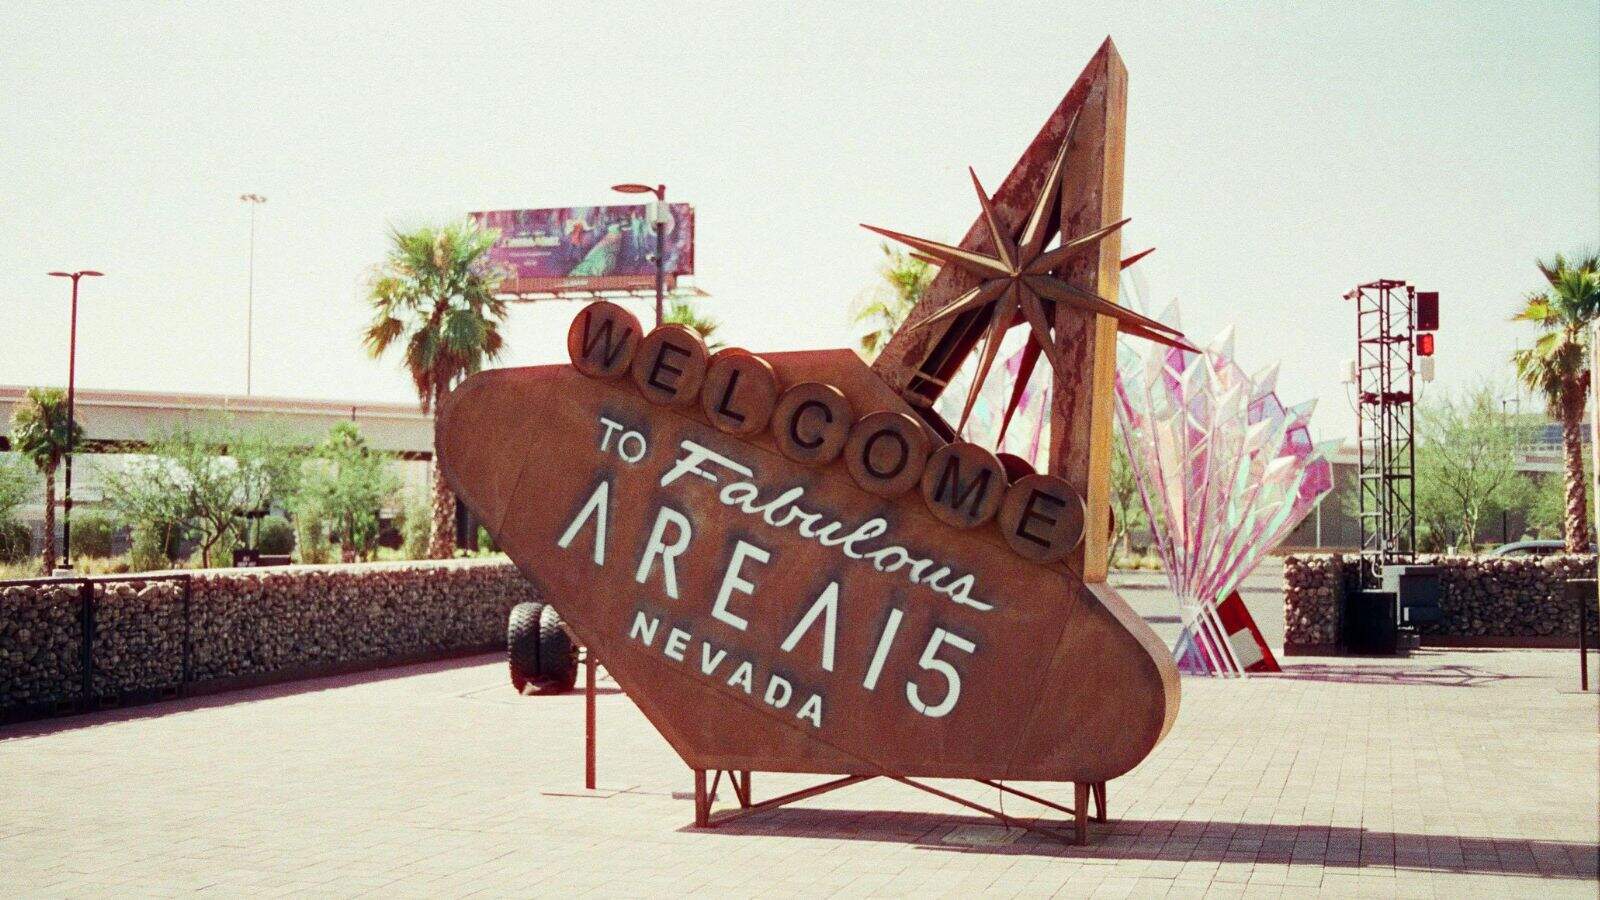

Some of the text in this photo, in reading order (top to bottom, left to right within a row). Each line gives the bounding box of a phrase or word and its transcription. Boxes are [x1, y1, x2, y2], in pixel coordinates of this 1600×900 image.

[582, 309, 1066, 547] WELCOME
[600, 417, 994, 611] TO Fabulous
[557, 480, 976, 718] AREA15
[629, 611, 823, 728] NEVADA
